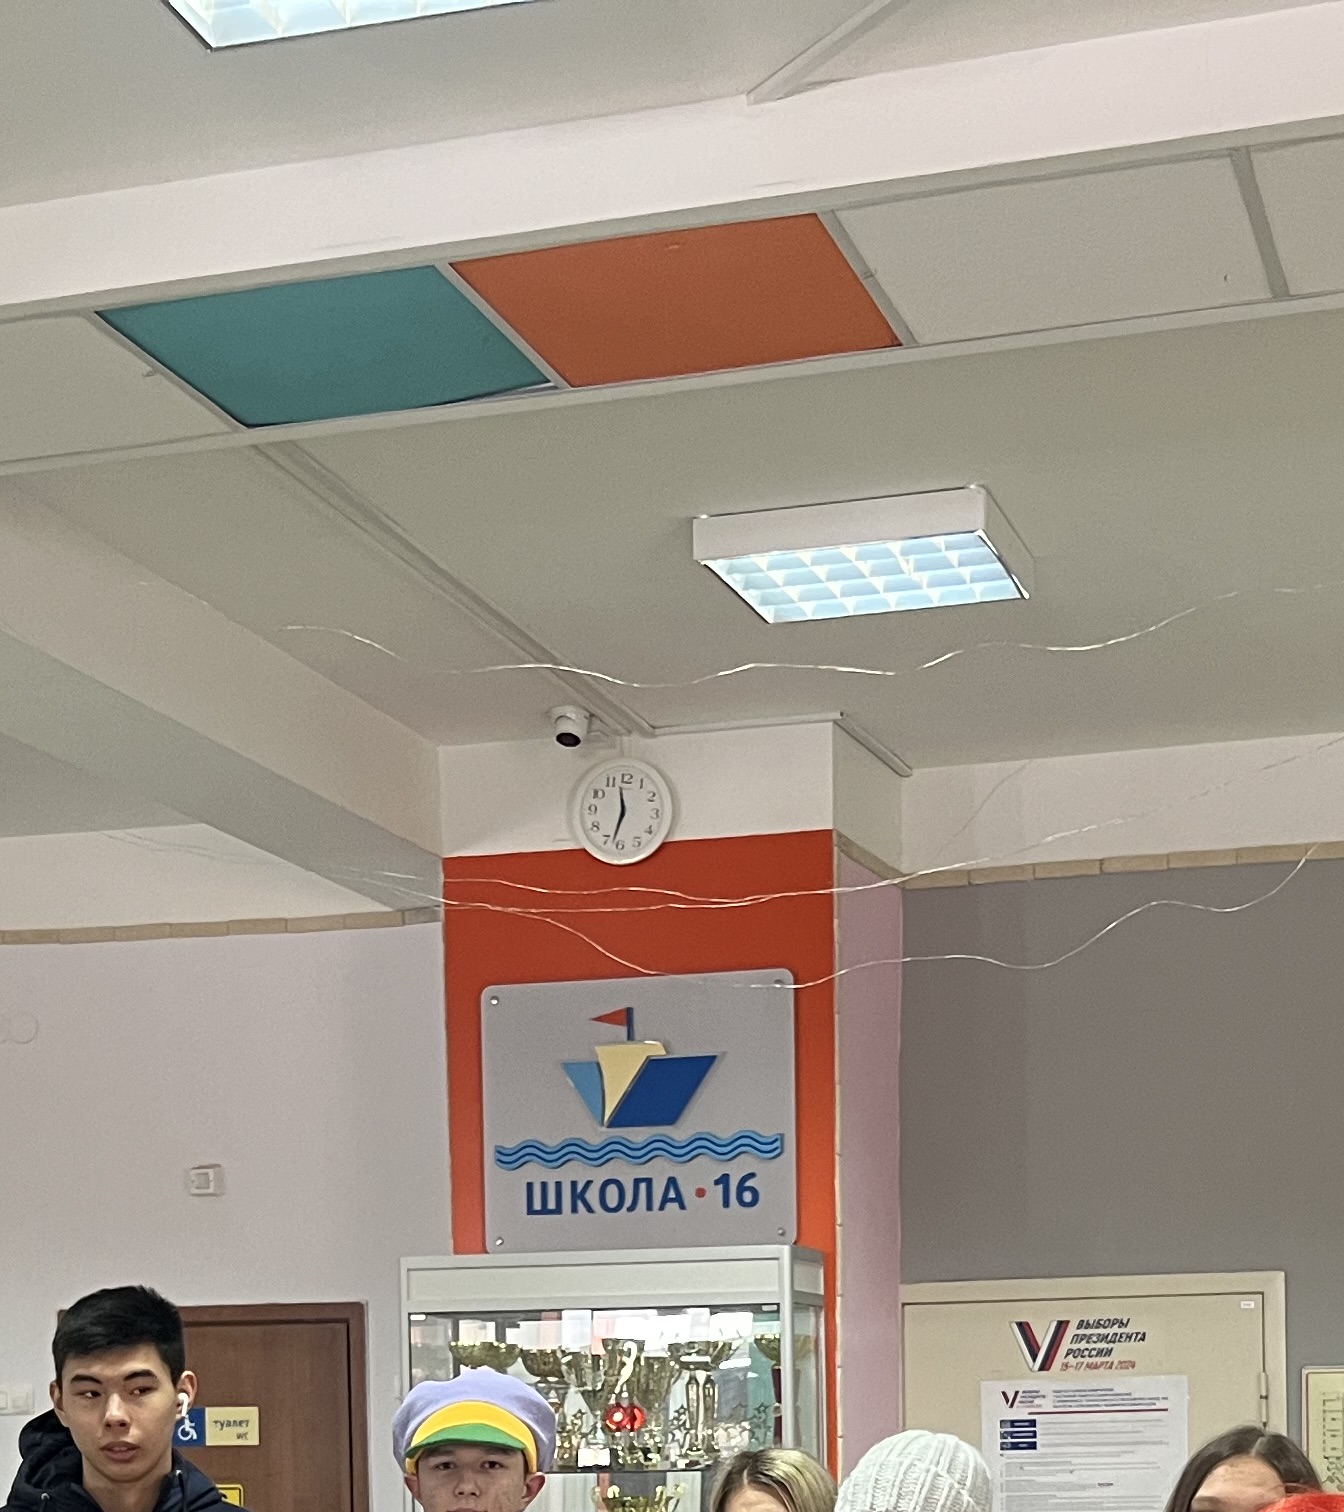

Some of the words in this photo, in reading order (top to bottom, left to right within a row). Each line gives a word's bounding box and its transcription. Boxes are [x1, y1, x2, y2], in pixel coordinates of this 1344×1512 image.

[606, 776, 616, 788] 11
[621, 773, 633, 784] 12
[639, 777, 644, 790] 1
[592, 788, 606, 800] 10
[646, 790, 656, 803] 2
[587, 804, 598, 815] 9
[649, 808, 660, 820] 3
[589, 821, 601, 832] 8
[644, 824, 653, 835] 4
[602, 834, 611, 846] 7
[615, 840, 625, 851] 6
[632, 836, 642, 848] 5
[526, 1175, 688, 1216] ШКОЛА
[713, 1171, 761, 1210] 16
[1075, 1317, 1131, 1331] ВЫБОРЫ
[1069, 1331, 1147, 1345] ПРЕЗИДЕНТА
[1064, 1347, 1114, 1360] РОССИИ
